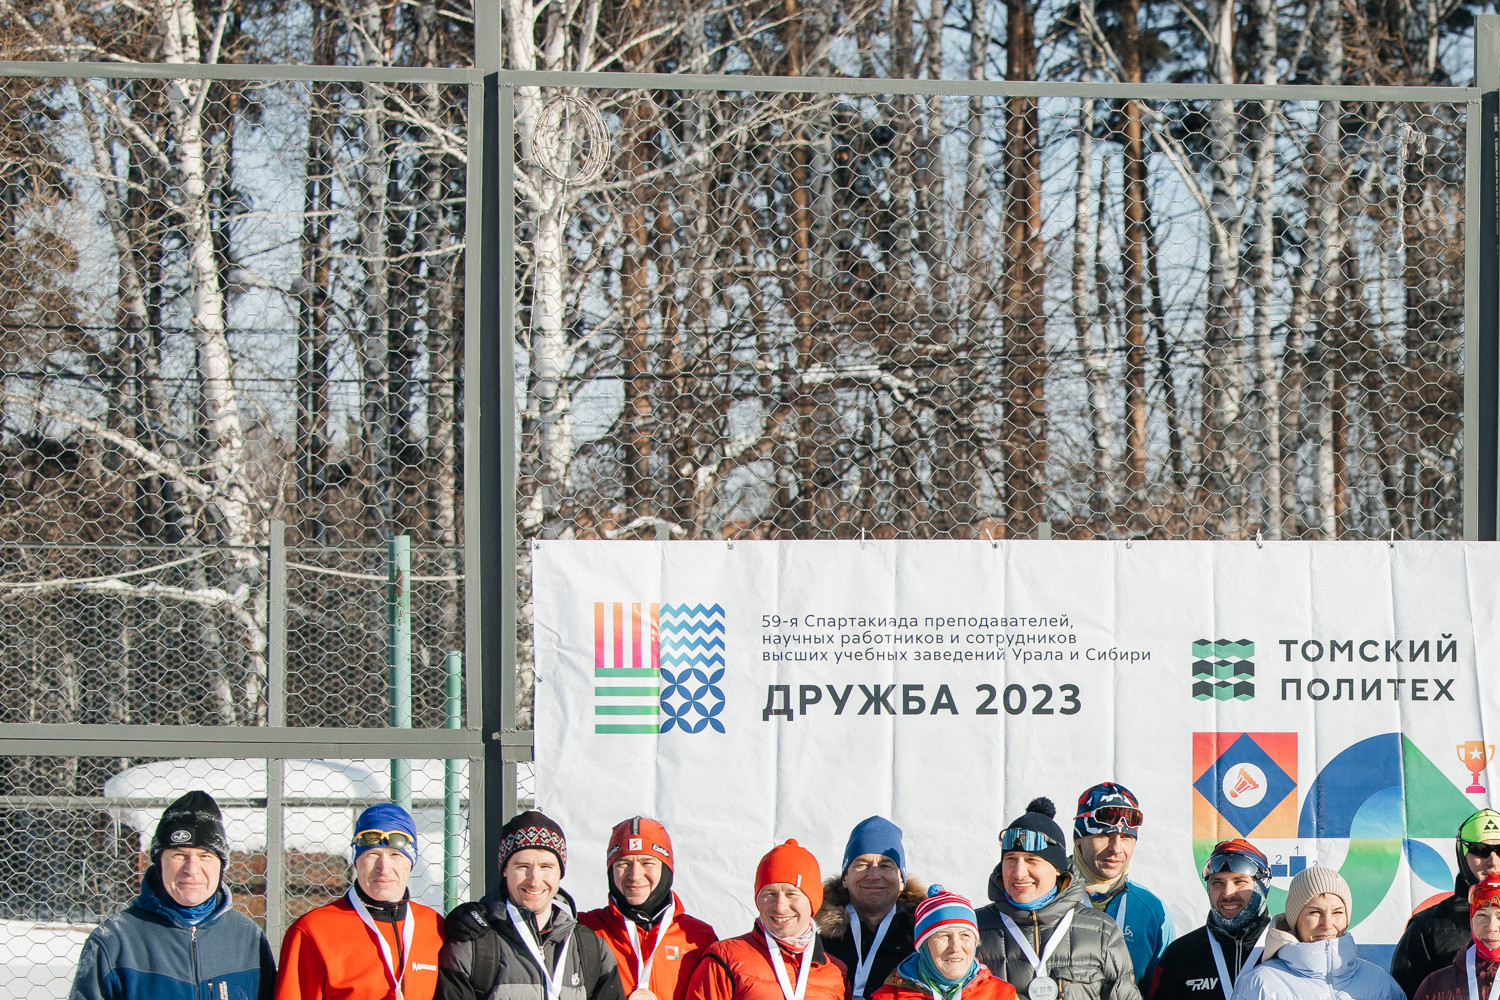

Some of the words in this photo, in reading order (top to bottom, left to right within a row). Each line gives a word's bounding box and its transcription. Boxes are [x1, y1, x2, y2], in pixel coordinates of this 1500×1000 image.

[762, 614, 798, 628] 59-я
[804, 614, 918, 630] Спартакиада
[924, 613, 1074, 630] преподавателей,
[762, 633, 835, 647] научных
[840, 630, 944, 647] работников
[950, 633, 960, 644] и
[966, 633, 1077, 647] сотрудников
[762, 651, 828, 661] высших
[834, 648, 908, 664] учебных
[914, 648, 1006, 663] заведений
[1012, 648, 1064, 664] Урала
[1070, 651, 1079, 661] и
[1085, 647, 1151, 664] Сибири
[1278, 633, 1458, 663] ТОМСКИЙ
[1280, 678, 1455, 701] ПОЛИТЕХ
[762, 684, 959, 721] ДРУЖБА
[975, 683, 1082, 715] 2023
[1294, 845, 1299, 855] 1
[1275, 854, 1282, 864] 2
